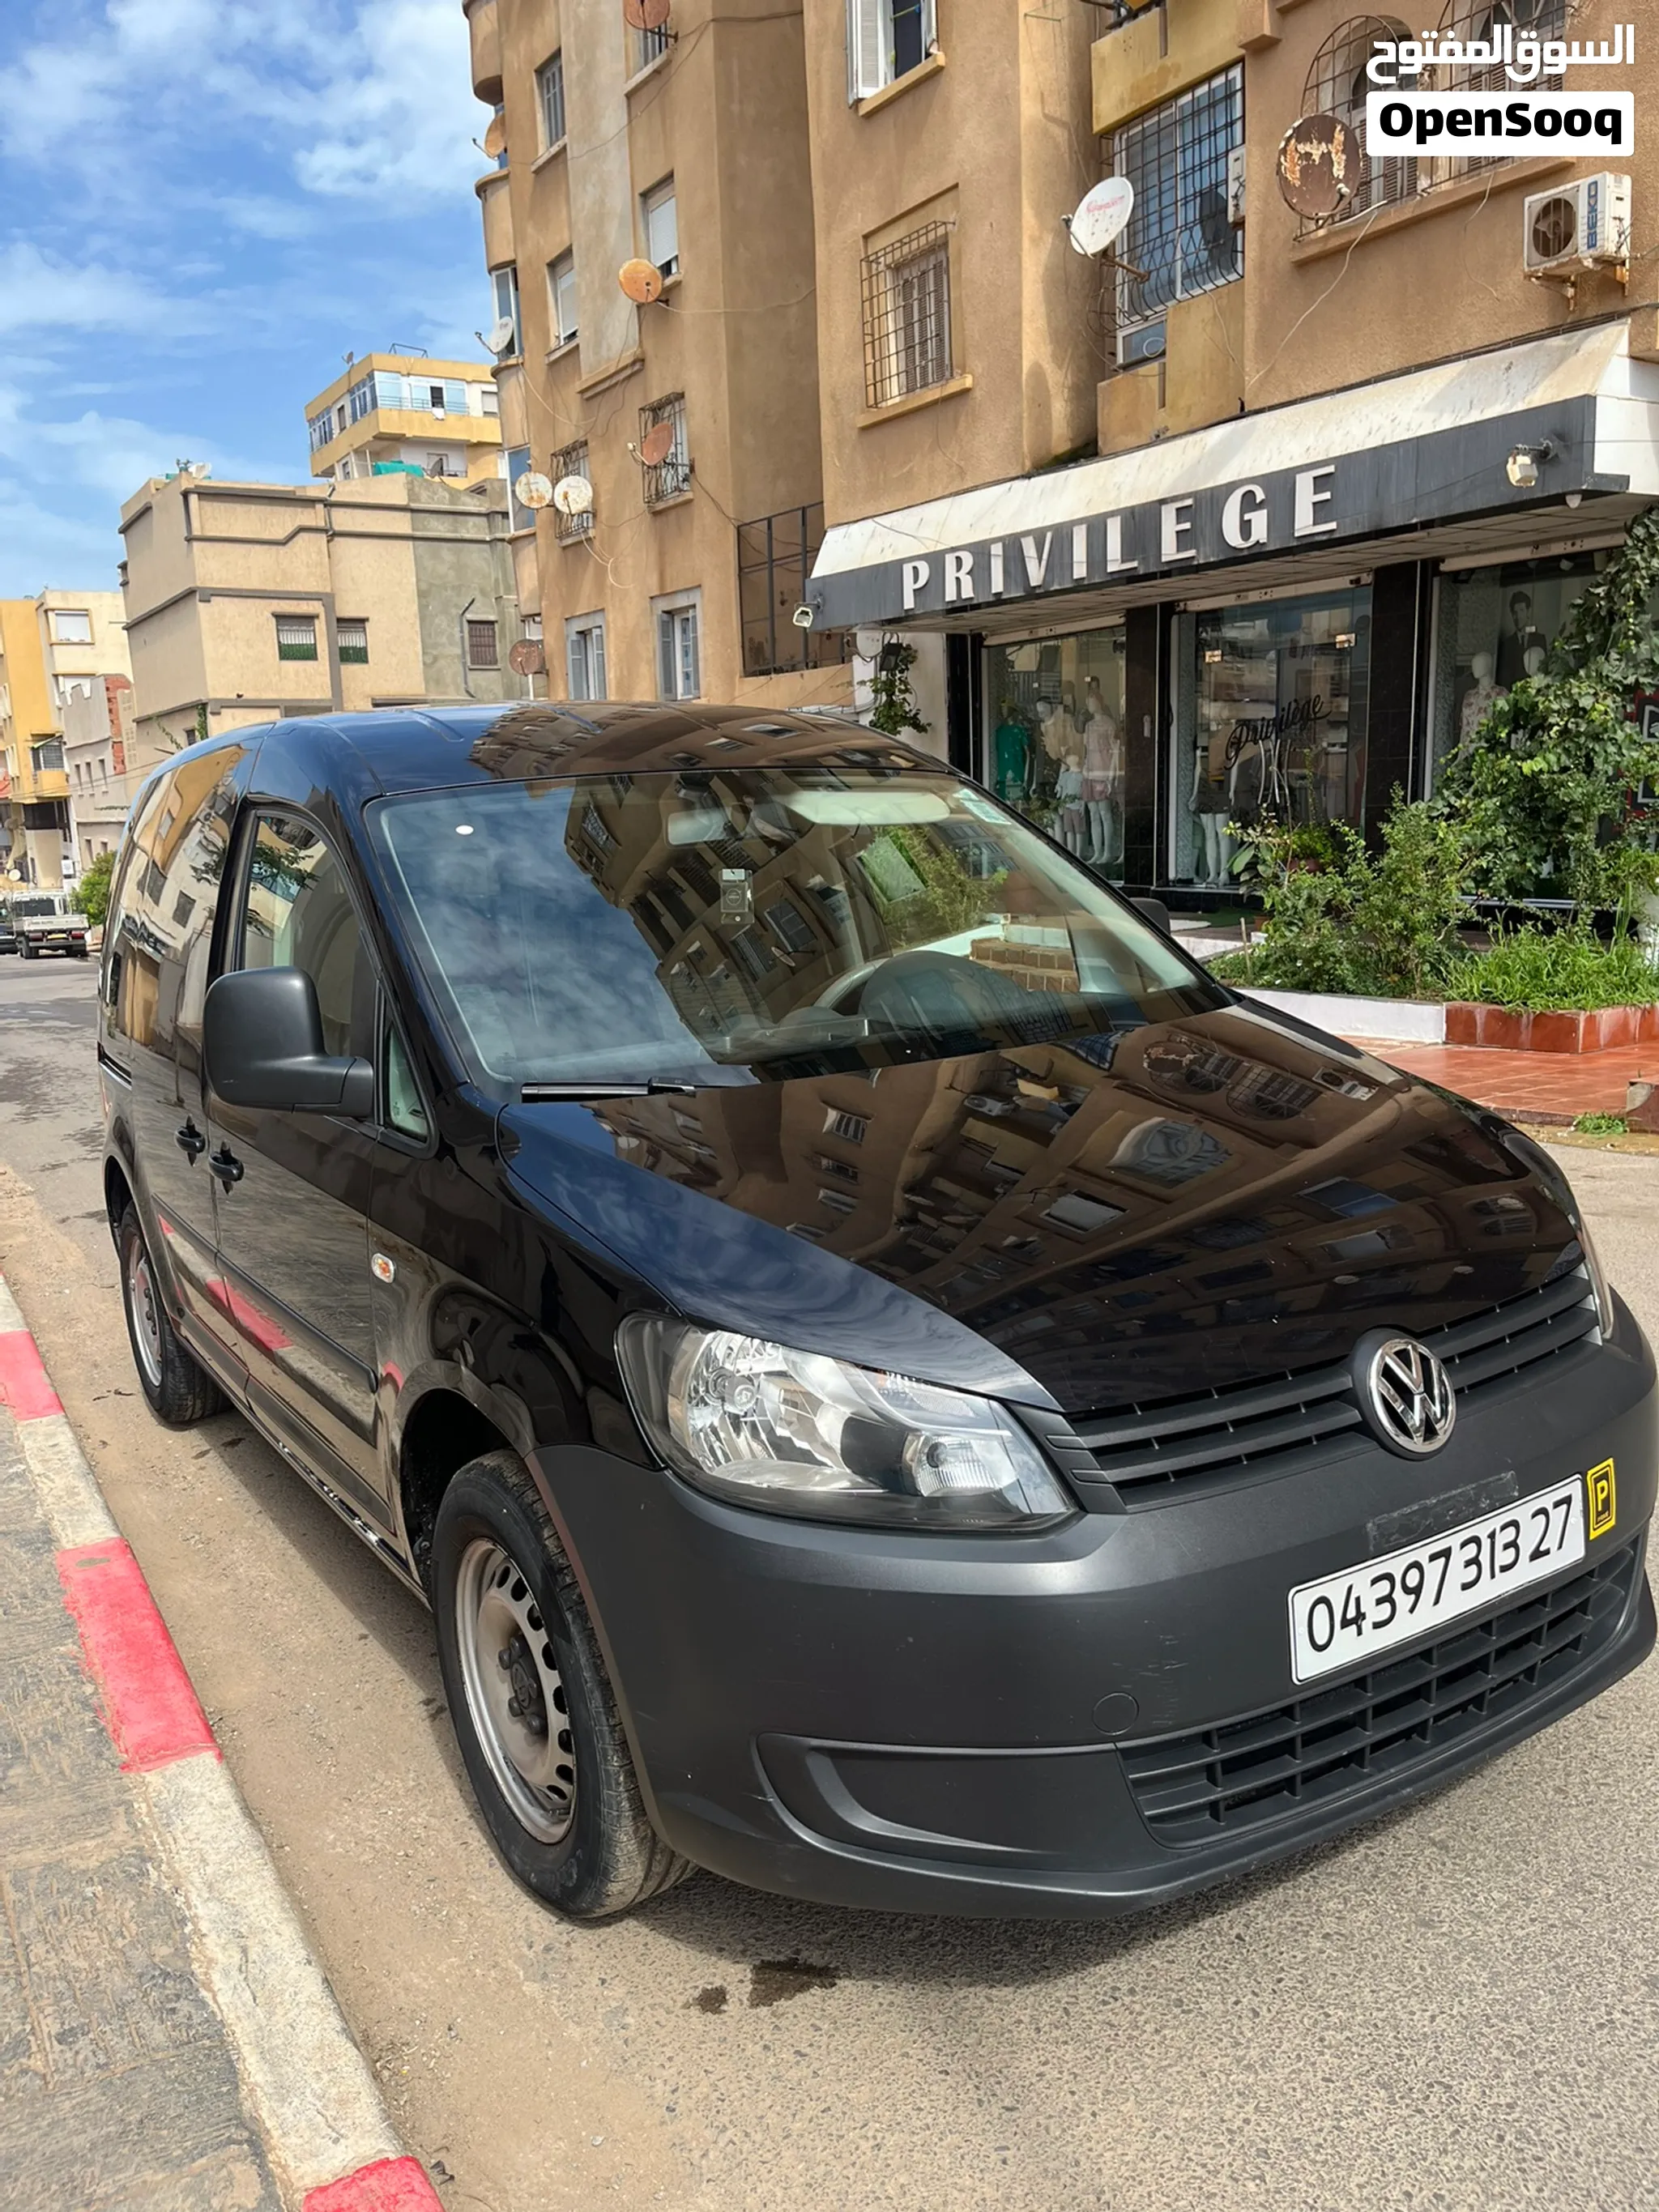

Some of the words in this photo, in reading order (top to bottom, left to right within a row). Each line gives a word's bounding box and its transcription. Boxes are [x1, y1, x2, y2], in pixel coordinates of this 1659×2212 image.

[1587, 181, 1598, 249] BEKO
[902, 464, 1337, 610] PRIVILEGE
[1529, 1494, 1573, 1563] 27
[1597, 1480, 1608, 1511] P
